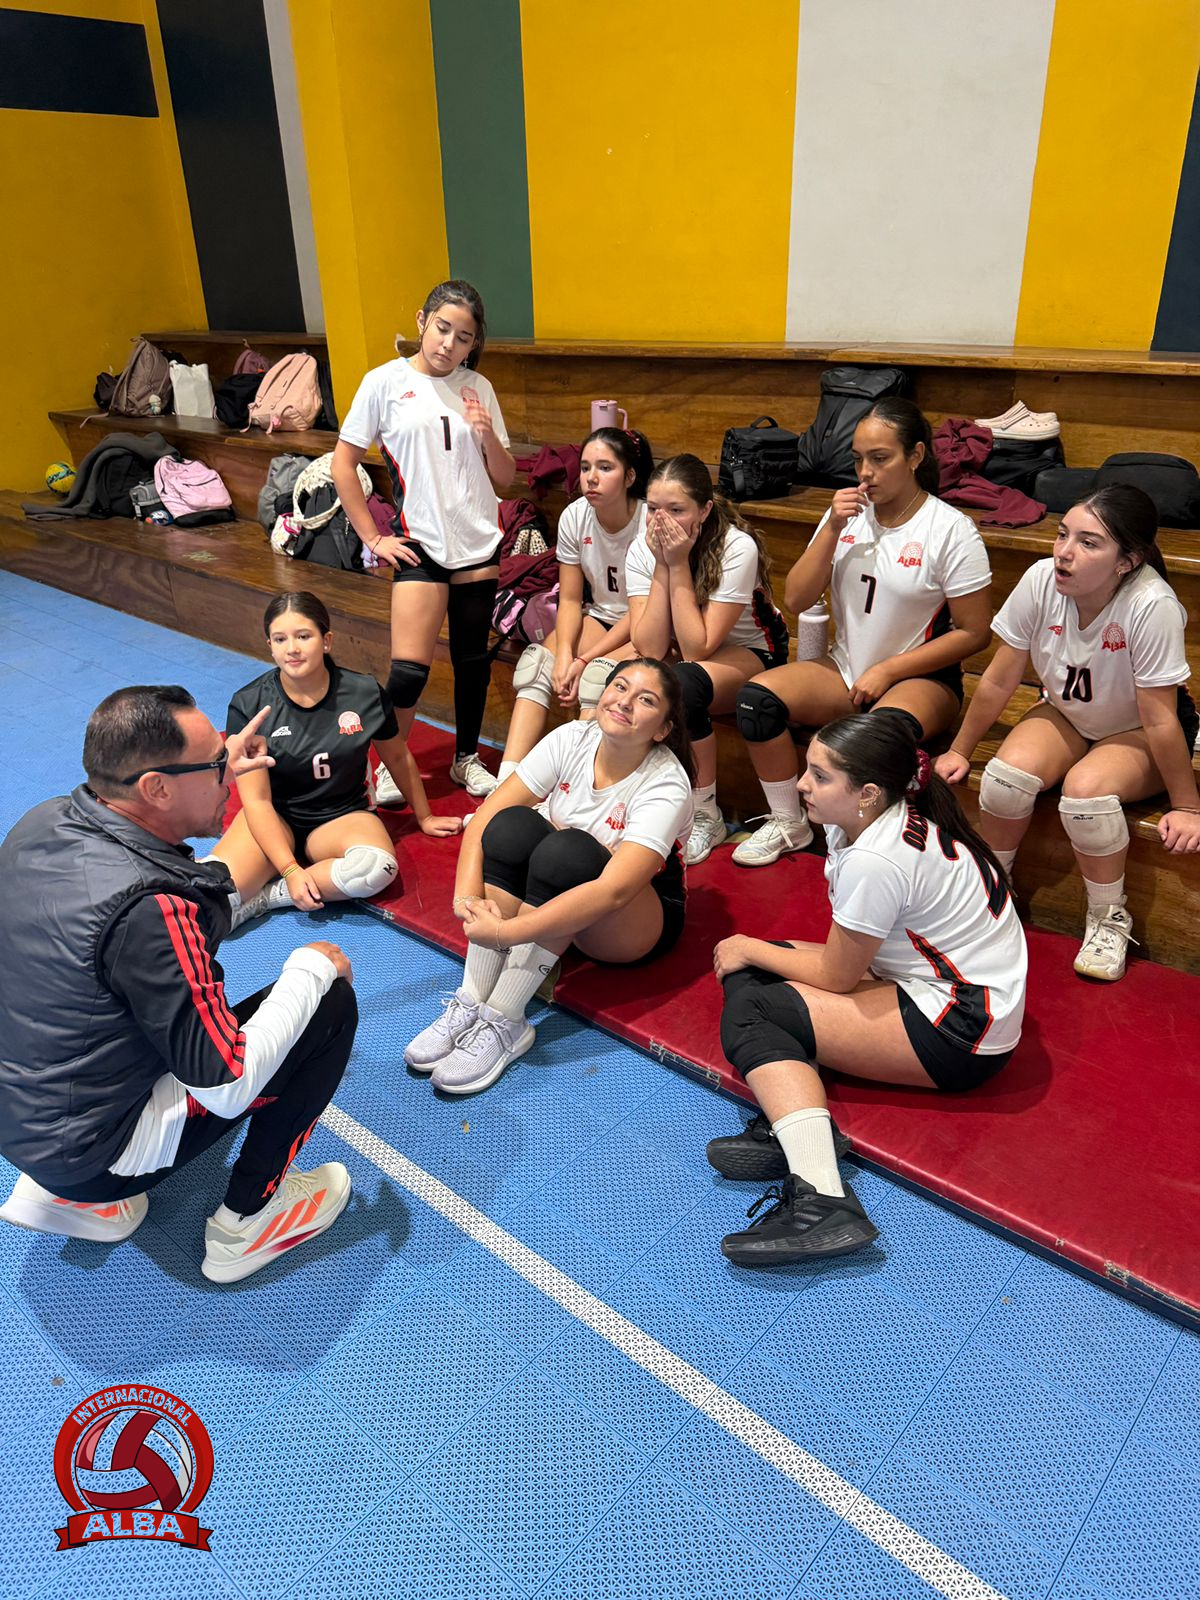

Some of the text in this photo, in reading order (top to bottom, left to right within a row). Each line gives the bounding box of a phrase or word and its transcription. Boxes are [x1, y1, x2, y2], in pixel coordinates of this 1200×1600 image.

[440, 415, 452, 451] 1
[896, 555, 922, 568] ALBA
[607, 565, 619, 593] 6
[860, 573, 877, 614] 7
[1061, 664, 1093, 703] 10
[312, 752, 331, 780] 6
